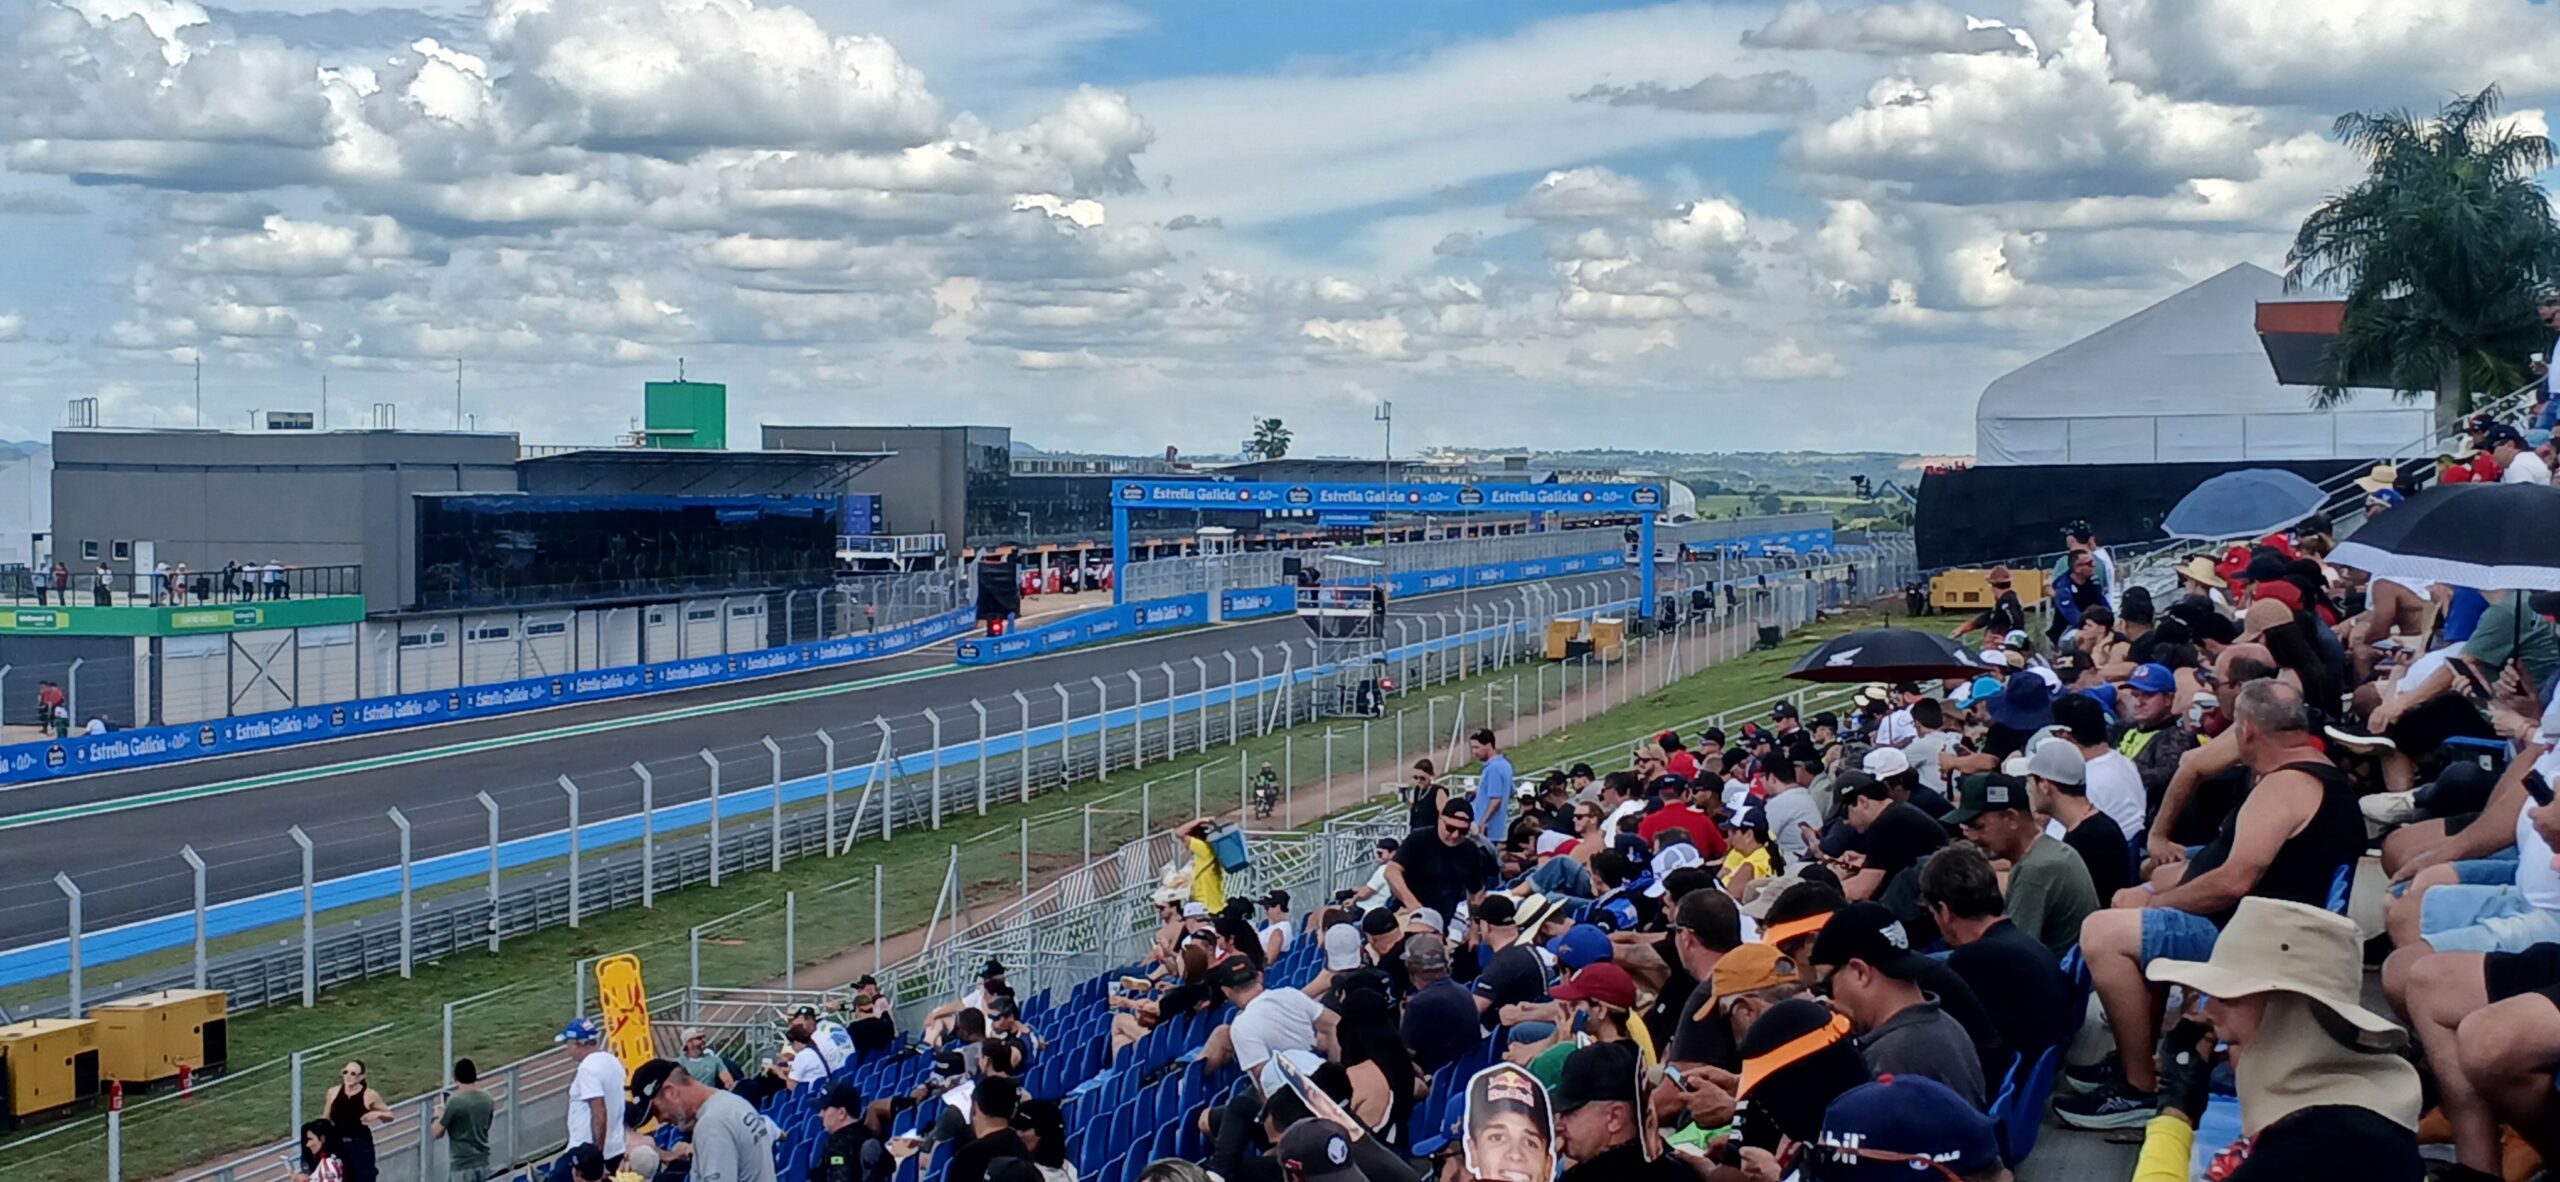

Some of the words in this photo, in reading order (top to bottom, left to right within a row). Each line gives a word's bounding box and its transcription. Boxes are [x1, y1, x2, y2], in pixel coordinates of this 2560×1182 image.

[1152, 487, 1195, 500] Estrella
[1196, 488, 1236, 501] Galicia
[1320, 489, 1363, 502] Estrella
[1364, 489, 1405, 503] Galcia
[1491, 490, 1537, 503] Estrella
[1538, 490, 1578, 503] Galicia
[89, 743, 130, 762] Estrella
[130, 734, 167, 757] Galicia
